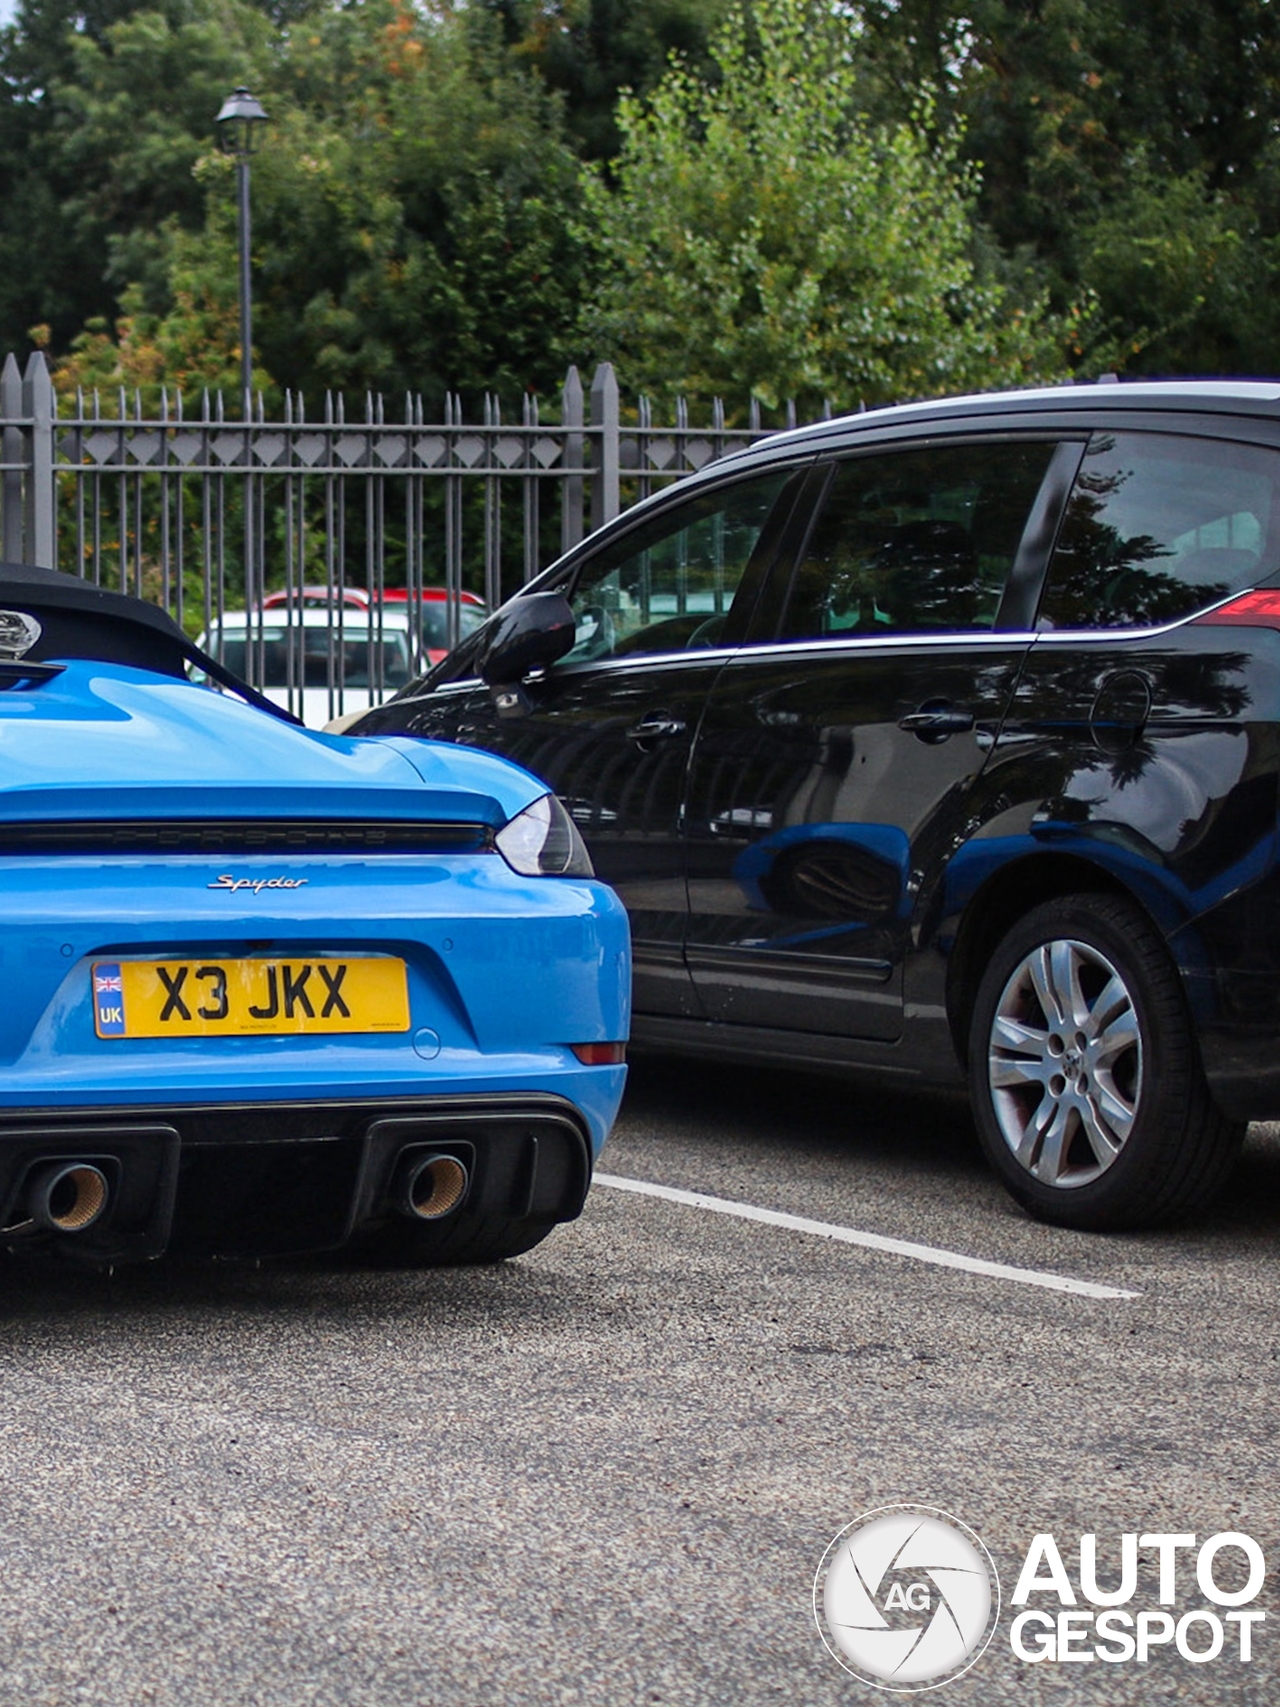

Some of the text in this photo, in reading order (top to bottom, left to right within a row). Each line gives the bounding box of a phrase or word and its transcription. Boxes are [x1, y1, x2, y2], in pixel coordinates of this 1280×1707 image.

[207, 874, 309, 894] Spyder
[156, 965, 351, 1021] X3 JKX
[100, 1007, 122, 1023] UK
